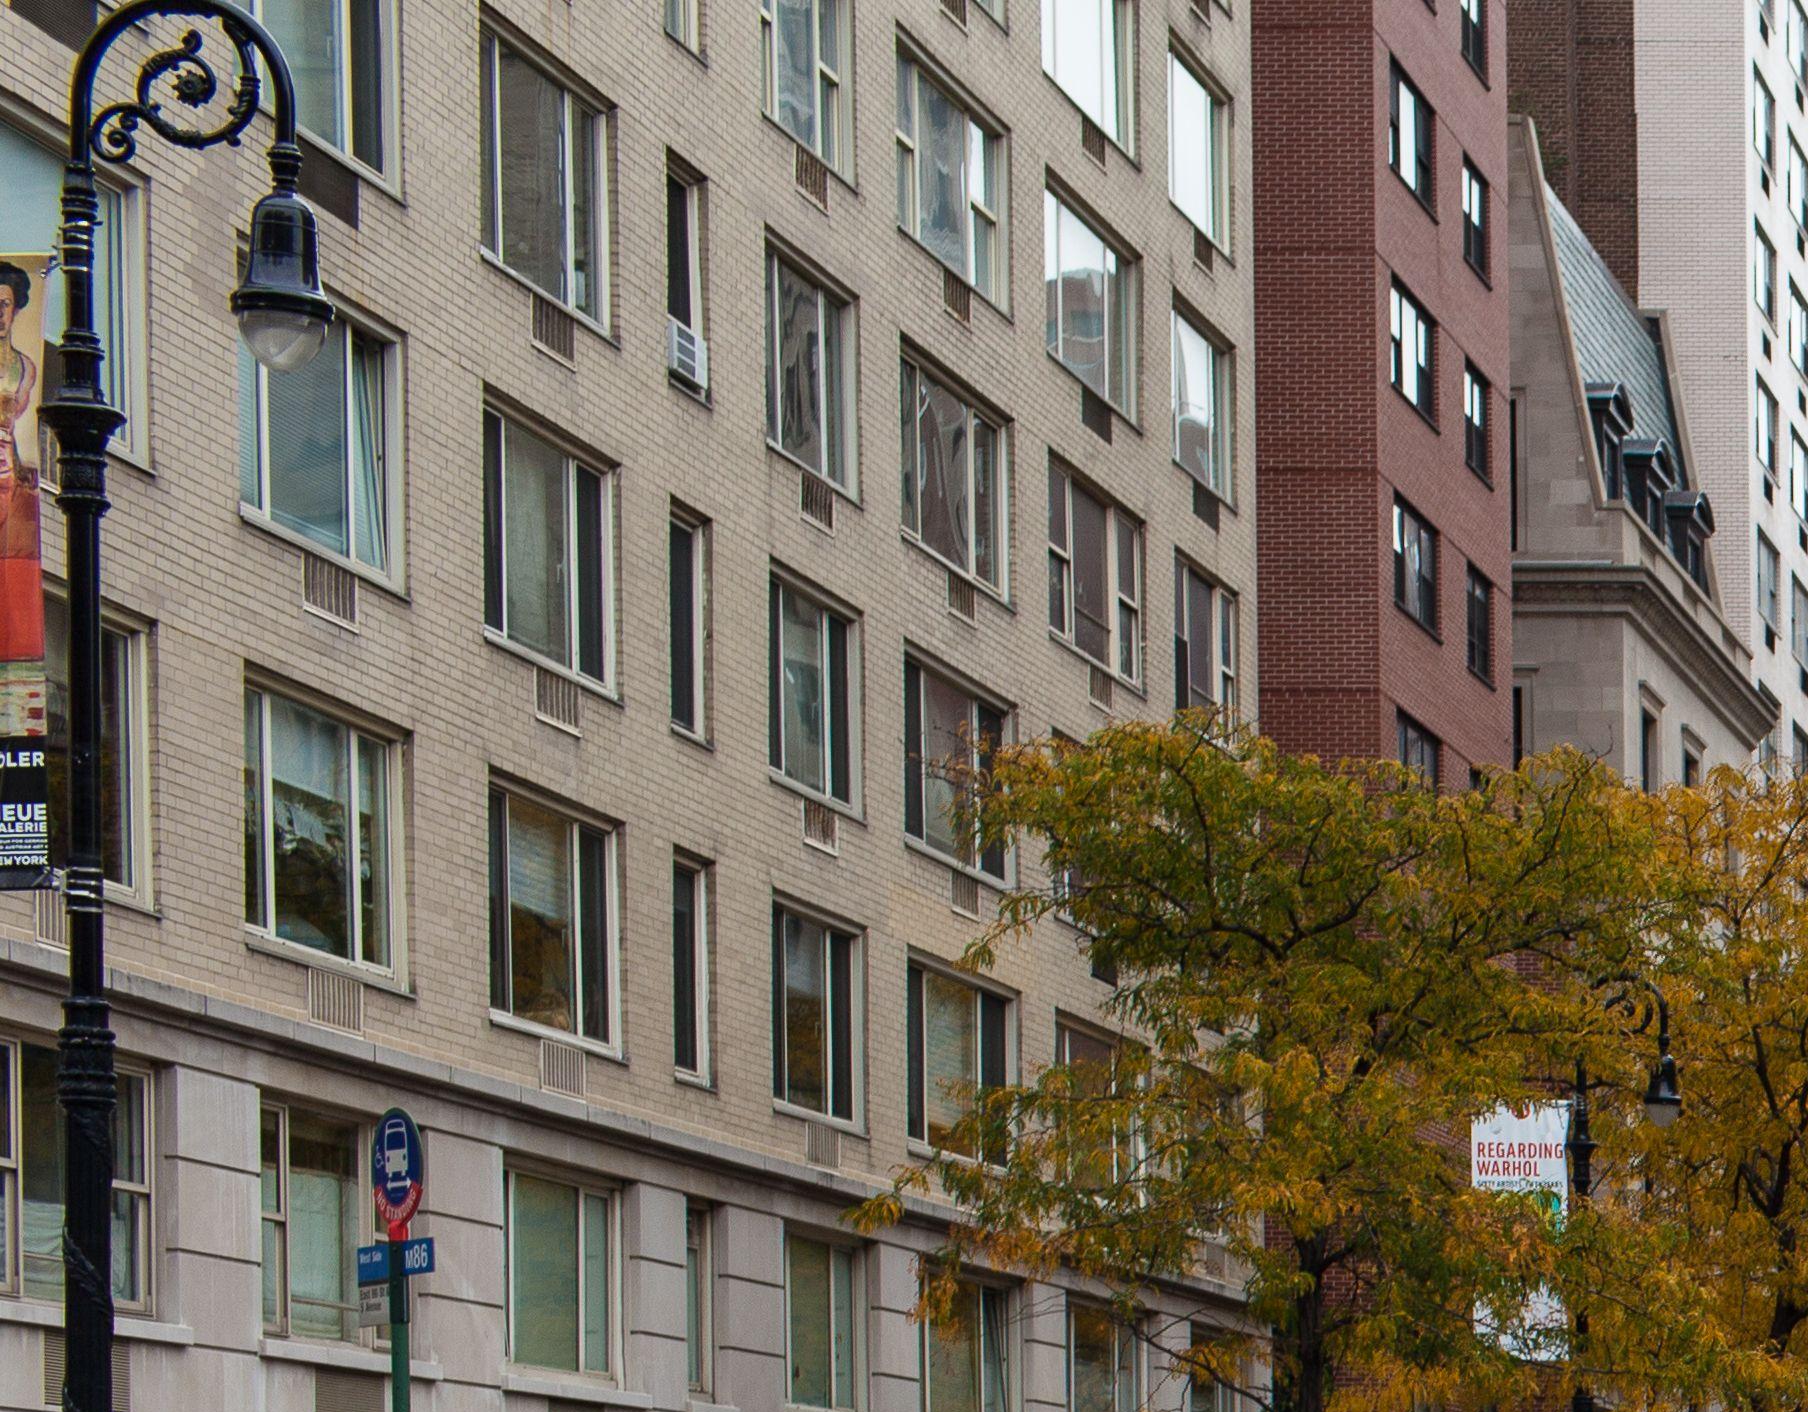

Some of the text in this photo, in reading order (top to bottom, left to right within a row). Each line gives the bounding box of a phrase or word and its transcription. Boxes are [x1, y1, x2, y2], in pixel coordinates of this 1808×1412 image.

[14, 855, 48, 866] YORK
[1477, 1142, 1563, 1159] REGARDING
[1477, 1160, 1540, 1177] WARHOL
[405, 1243, 428, 1269] M86
